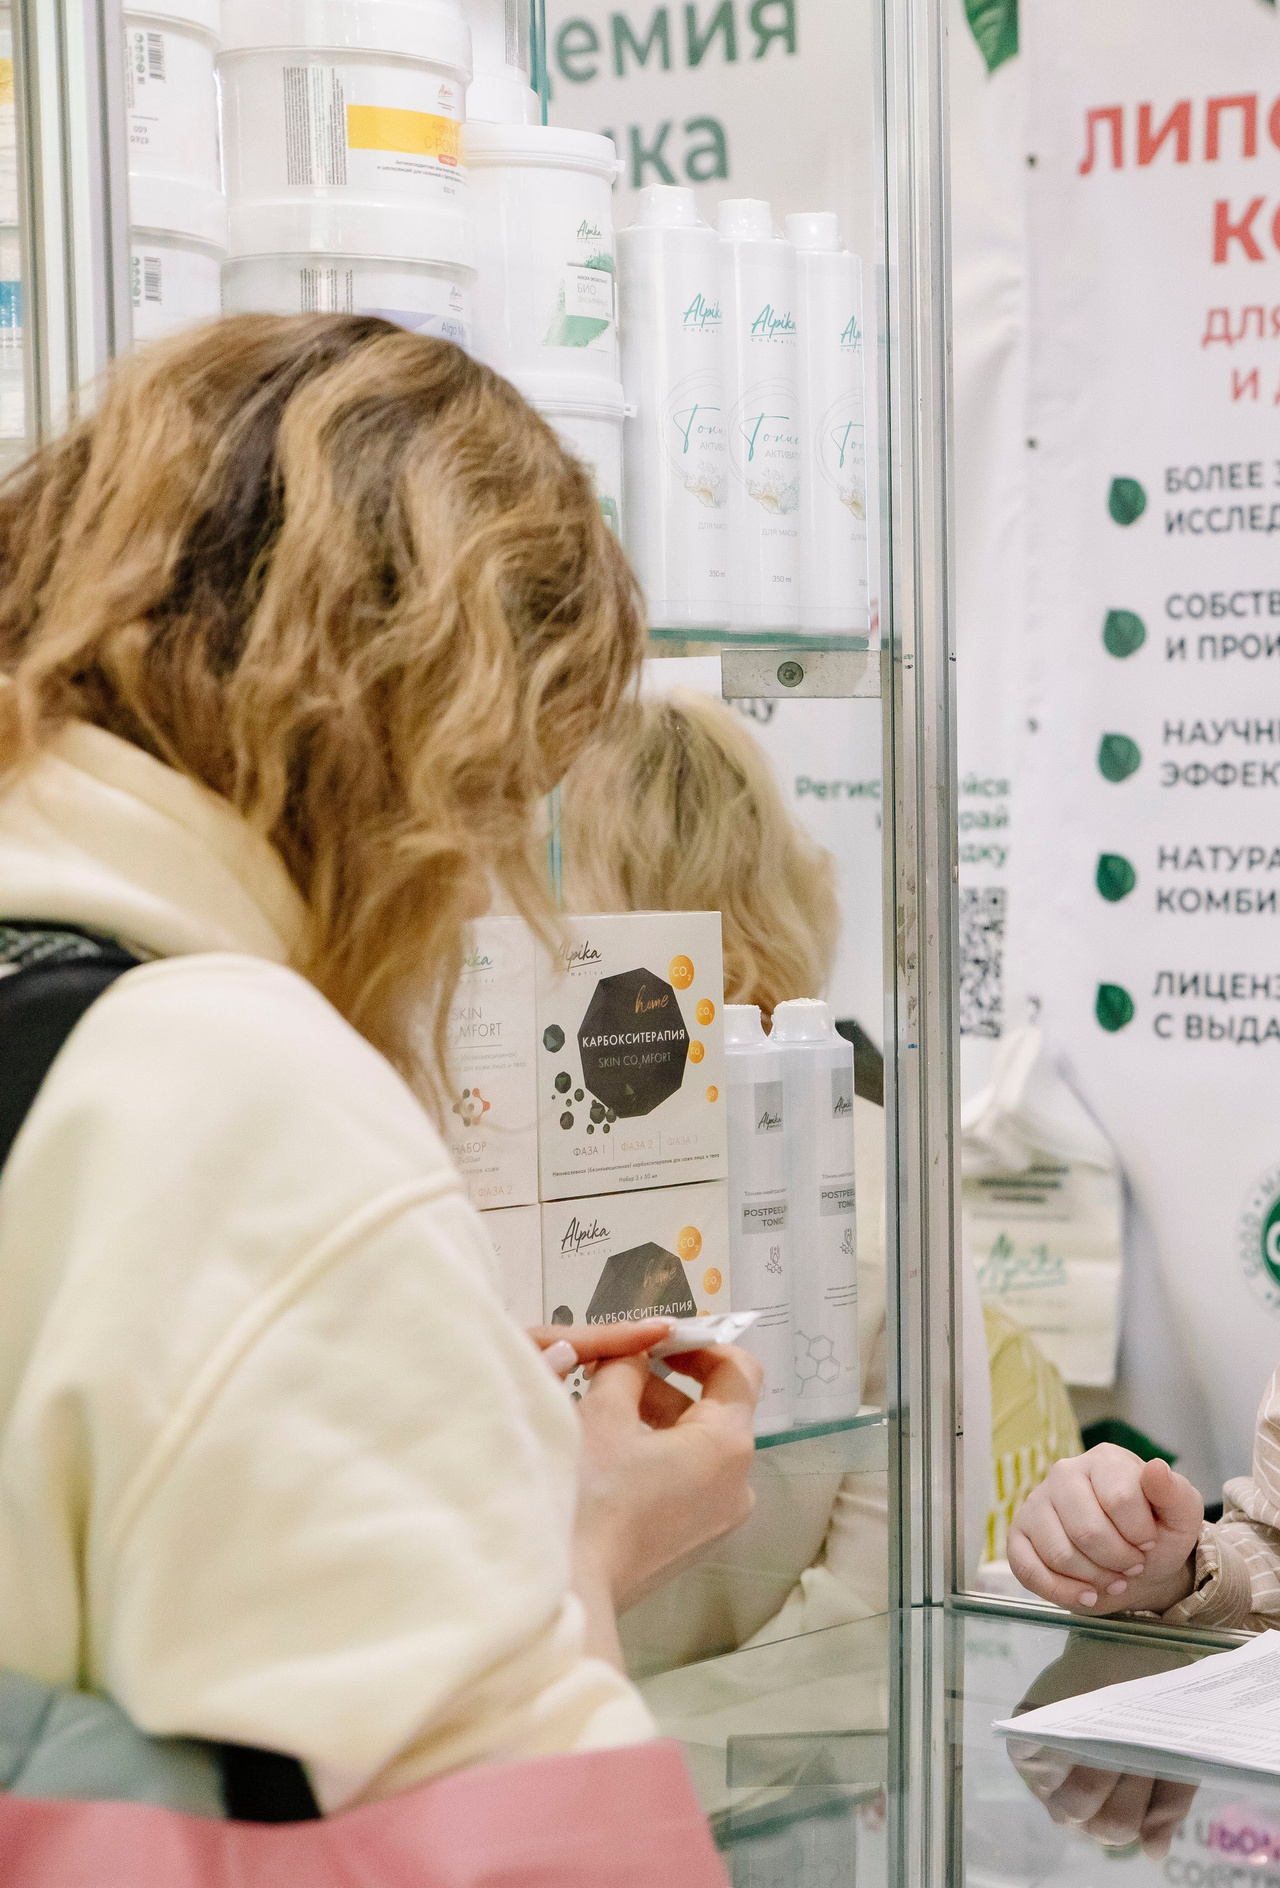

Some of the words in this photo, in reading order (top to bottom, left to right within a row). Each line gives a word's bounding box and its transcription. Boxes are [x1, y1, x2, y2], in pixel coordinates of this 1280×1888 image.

[550, 0, 796, 90] емия
[577, 219, 602, 240] Alpika
[751, 304, 797, 338] Alpika
[841, 315, 862, 349] Alp
[1231, 367, 1260, 403] И
[1165, 461, 1263, 494] БОЛЕЕ
[1166, 636, 1187, 662] И
[635, 985, 669, 1014] home
[582, 1029, 685, 1048] КАРБОКСИТЕРАПИЯ
[1153, 1013, 1173, 1040] С
[598, 1056, 620, 1068] SKIN
[572, 1144, 599, 1157] ФАЗА
[620, 1141, 645, 1152] ФАЗА
[648, 1139, 654, 1150] 2
[667, 1136, 691, 1147] ФАЗА
[561, 1216, 610, 1252] Alpika
[761, 1216, 784, 1227] TONIC
[590, 1300, 693, 1326] КАРБОКСИТЕРАПИЯ
